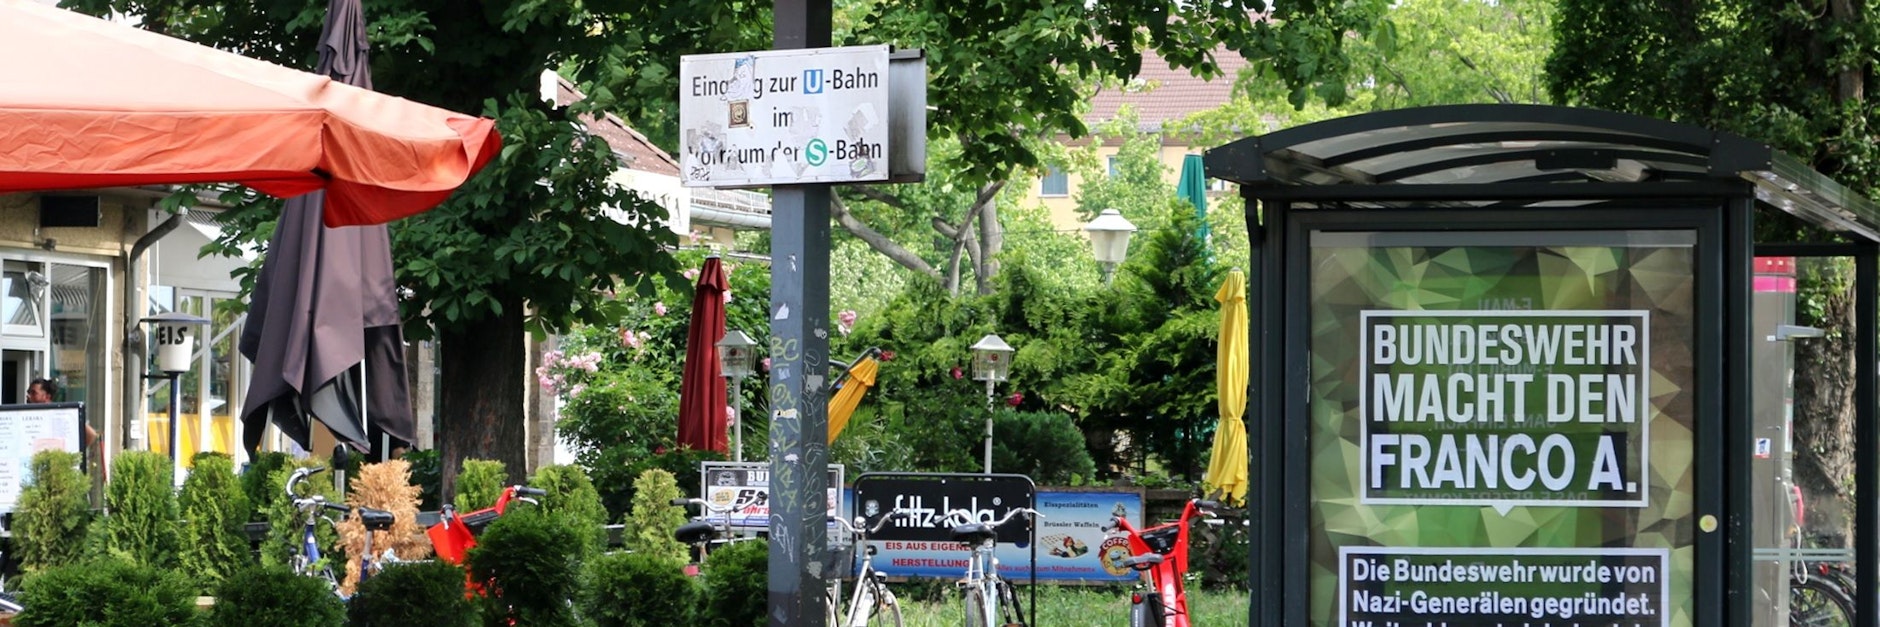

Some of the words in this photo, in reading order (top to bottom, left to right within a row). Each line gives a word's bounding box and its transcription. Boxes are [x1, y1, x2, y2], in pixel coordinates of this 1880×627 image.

[769, 77, 797, 92] zur
[804, 67, 878, 93] U-Bahn
[805, 137, 881, 167] S-Bahn
[159, 326, 187, 345] EIS
[1373, 324, 1637, 366] BUNDESWEHR
[1373, 373, 1533, 423] MACHT
[1547, 373, 1636, 423] DEN
[1371, 433, 1576, 491] FRANCO
[1588, 435, 1637, 493] A.
[885, 542, 903, 550] EIS
[906, 542, 928, 551] AUS
[892, 558, 970, 568] HERSTELLUNG
[1353, 558, 1391, 582] Die
[1394, 559, 1537, 583] Bundeswehr
[1540, 560, 1612, 583] wurde
[1613, 563, 1655, 583] von
[1353, 589, 1527, 613] Nazi-Generälen
[1531, 591, 1655, 616] gegründet.
